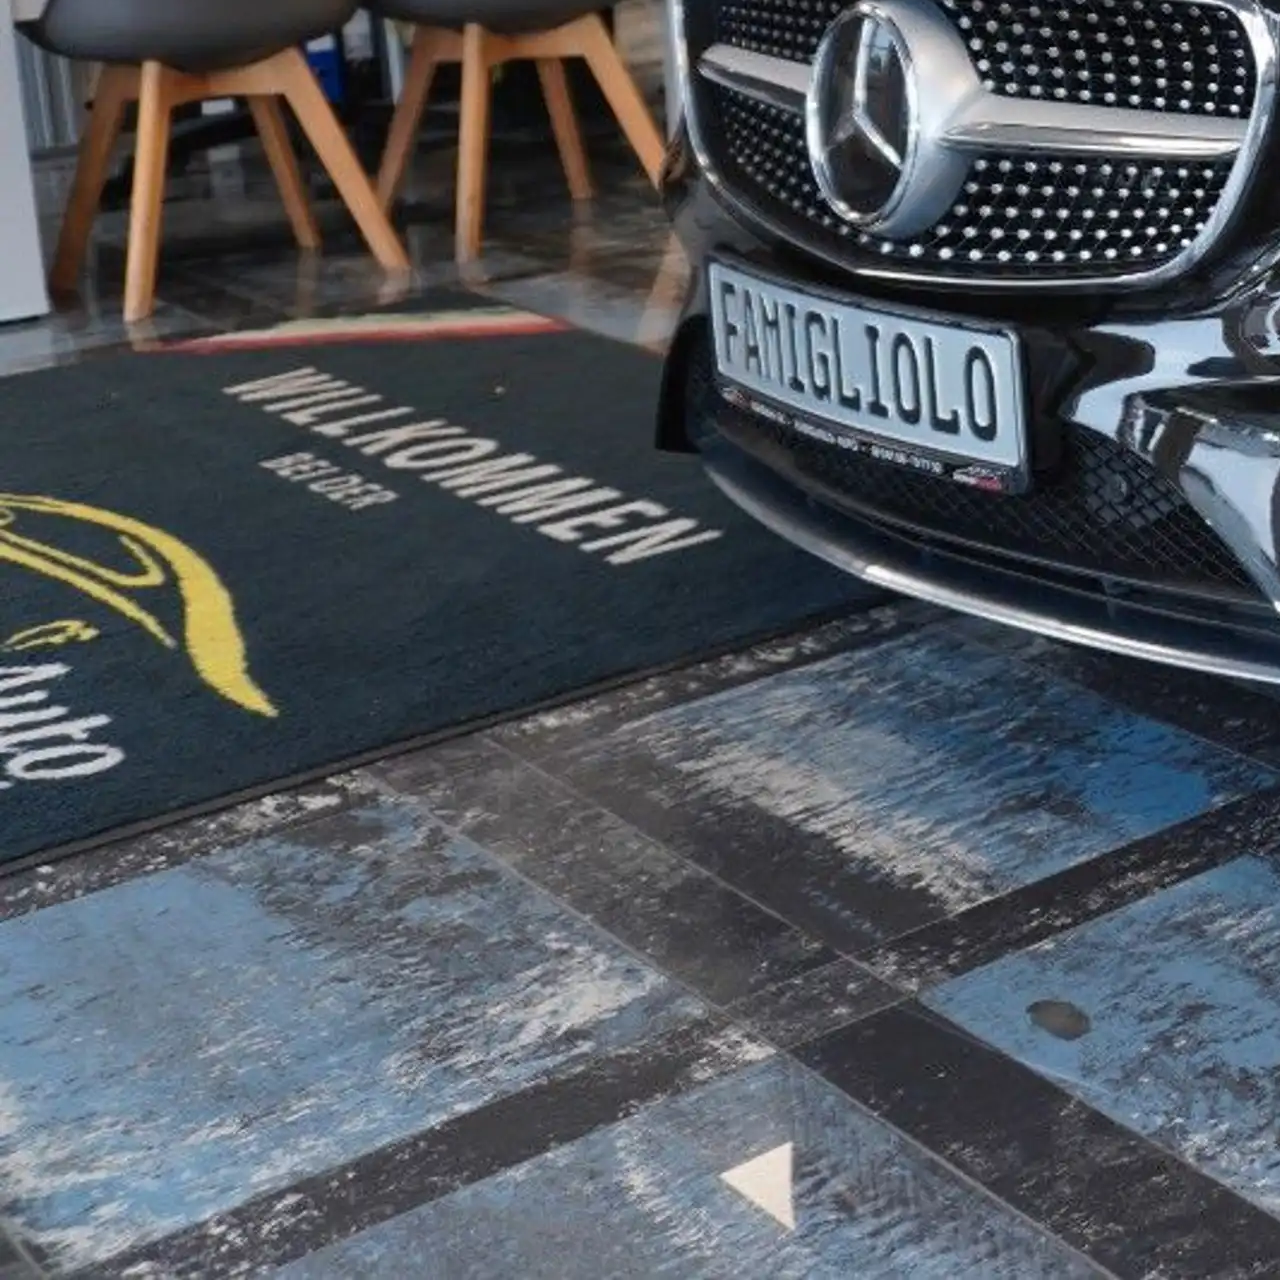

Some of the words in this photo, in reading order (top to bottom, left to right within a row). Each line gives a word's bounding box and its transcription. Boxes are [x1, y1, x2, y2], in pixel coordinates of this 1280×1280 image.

[719, 281, 999, 442] FAMIGLIOLO
[222, 366, 724, 565] WILLKOMMEN
[258, 451, 341, 482] BEI
[308, 474, 399, 511] DER
